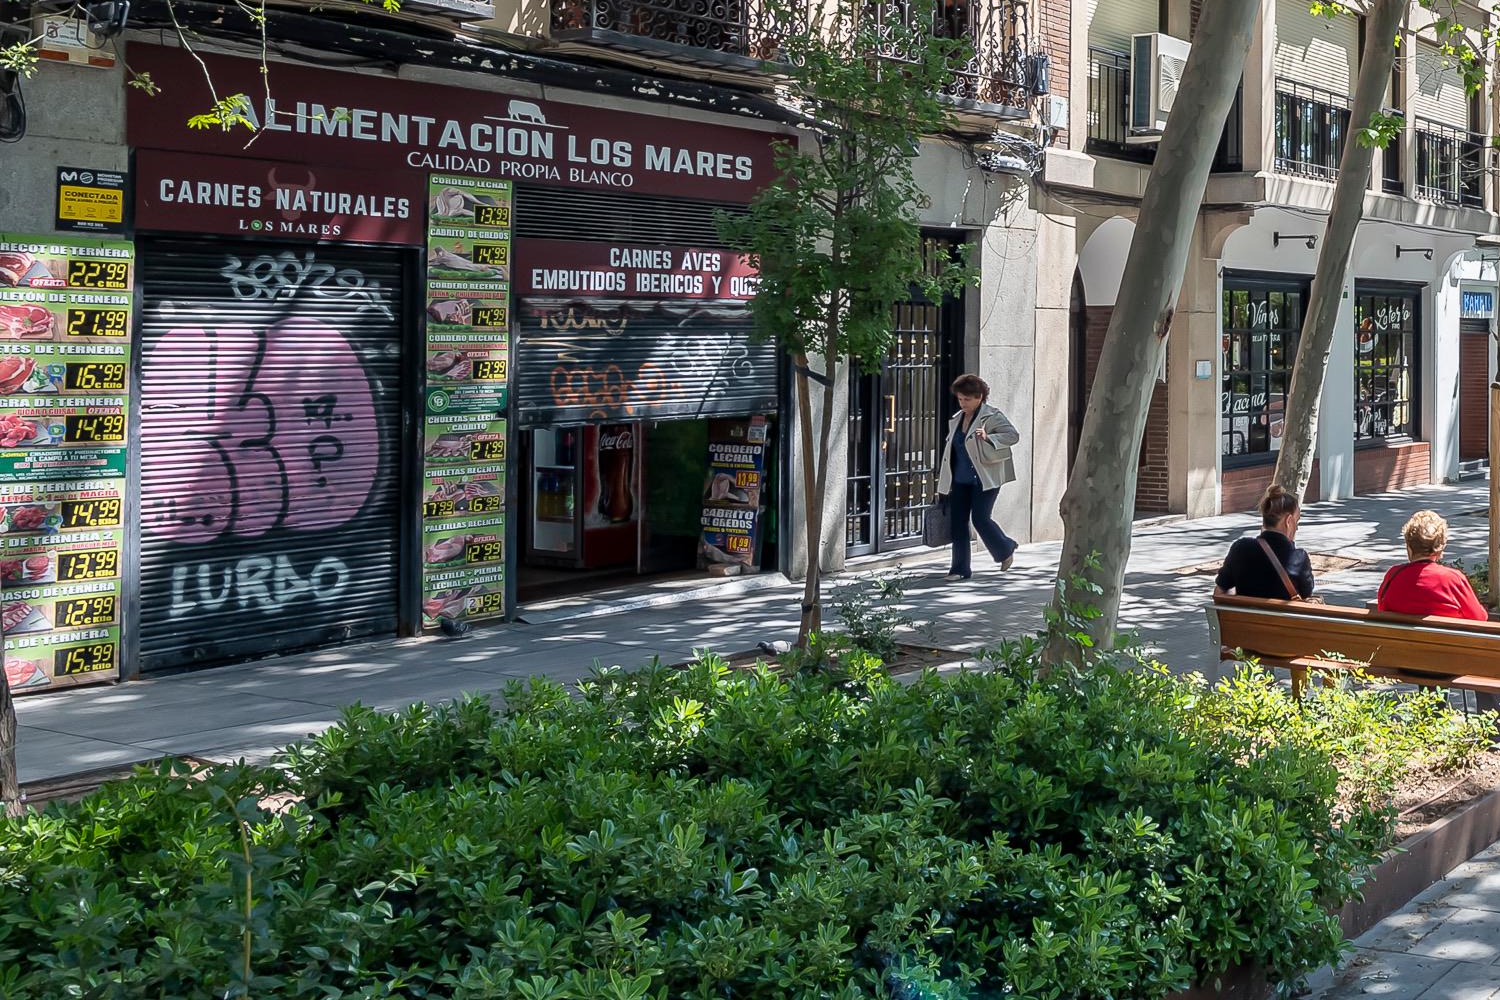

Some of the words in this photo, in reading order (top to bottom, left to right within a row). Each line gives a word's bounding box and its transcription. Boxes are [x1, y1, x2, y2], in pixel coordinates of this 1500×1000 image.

[230, 96, 553, 159] ALIMENTACION
[568, 135, 633, 168] LOS
[645, 145, 752, 180] MARES
[407, 151, 491, 174] CALIDAD
[501, 162, 560, 180] PROPIA
[570, 168, 633, 187] BLANCO
[432, 177, 474, 187] CORDERO
[477, 181, 508, 189] LECHAL
[64, 191, 118, 200] CONECTADA
[160, 179, 261, 207] CARNES
[276, 188, 409, 218] NATURALES
[280, 223, 341, 235] MARES
[431, 228, 464, 237] CABRITO
[479, 232, 509, 240] GREDOS
[50, 246, 66, 254] DE
[70, 247, 129, 258] TERNERA
[610, 248, 672, 270] CARNES
[681, 252, 721, 272] AVES
[532, 269, 626, 291] EMBUTIDOS
[636, 273, 703, 294] IBERICOS
[712, 276, 722, 295] Y
[49, 294, 66, 302] DE
[69, 295, 129, 304] TERNERA
[35, 345, 54, 354] DE
[58, 345, 124, 355] TERNERA
[34, 398, 53, 407] DE
[58, 398, 124, 406] TERNERA
[428, 415, 468, 424] CHULETAS
[452, 423, 487, 431] CABRITO
[709, 444, 762, 454] CORDERO
[714, 453, 754, 463] LECHAL
[425, 468, 465, 478] CHULETAS
[467, 466, 504, 474] RECENTAL
[13, 484, 33, 494] DE
[39, 481, 104, 492] TERNERA
[703, 508, 754, 520] CABRITO
[425, 522, 466, 532] PALETILLAS
[468, 518, 503, 527] RECENTAL
[713, 518, 752, 529] GREDOS
[9, 538, 28, 547] DE
[33, 533, 99, 545] TERNERA
[103, 531, 113, 540] 2
[426, 571, 465, 582] PALETILLA
[474, 566, 502, 575] PIERNA
[432, 581, 461, 590] LECHAL
[469, 575, 503, 584] CABRITO
[43, 588, 59, 597] DE
[61, 582, 115, 594] TERNERA
[19, 638, 39, 647] DE
[41, 629, 110, 645] TERNERA
